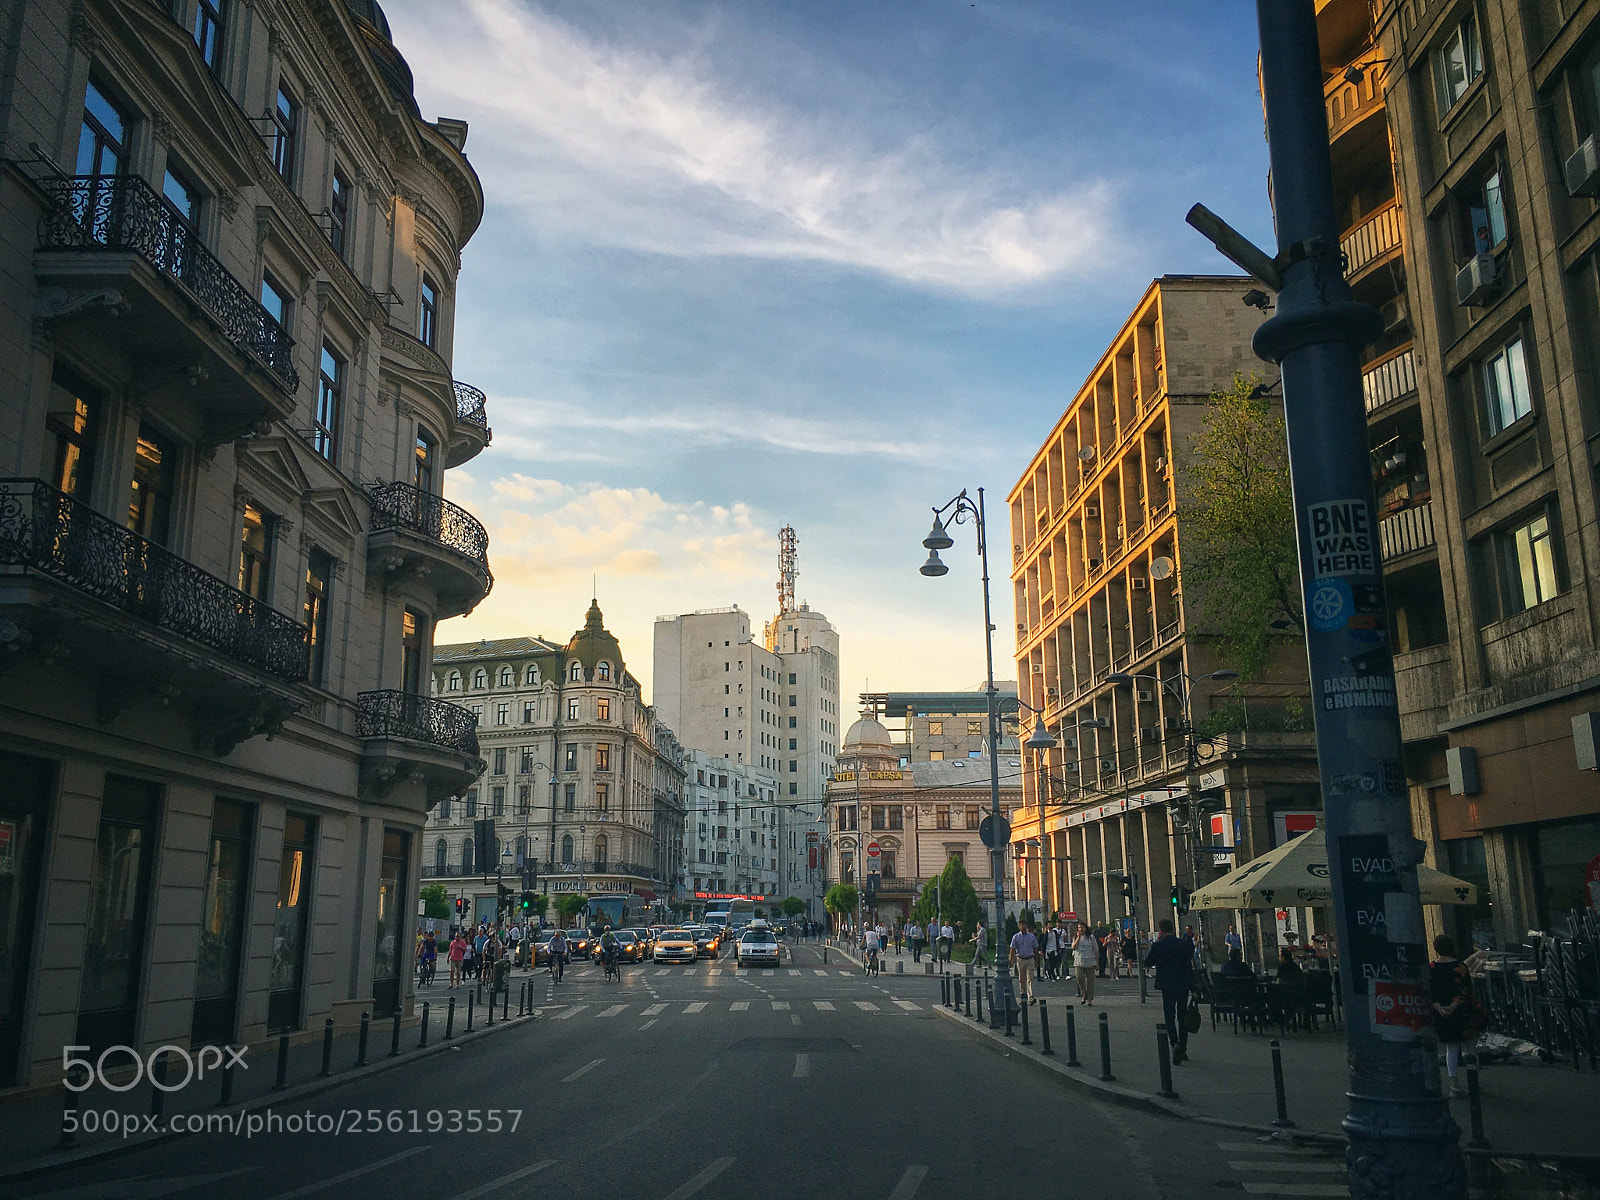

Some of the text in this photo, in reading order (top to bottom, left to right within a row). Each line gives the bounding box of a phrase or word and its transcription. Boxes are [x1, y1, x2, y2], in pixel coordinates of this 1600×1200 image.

[1312, 504, 1368, 538] BNE
[1316, 536, 1369, 555] WAS
[1318, 554, 1372, 574] HERE
